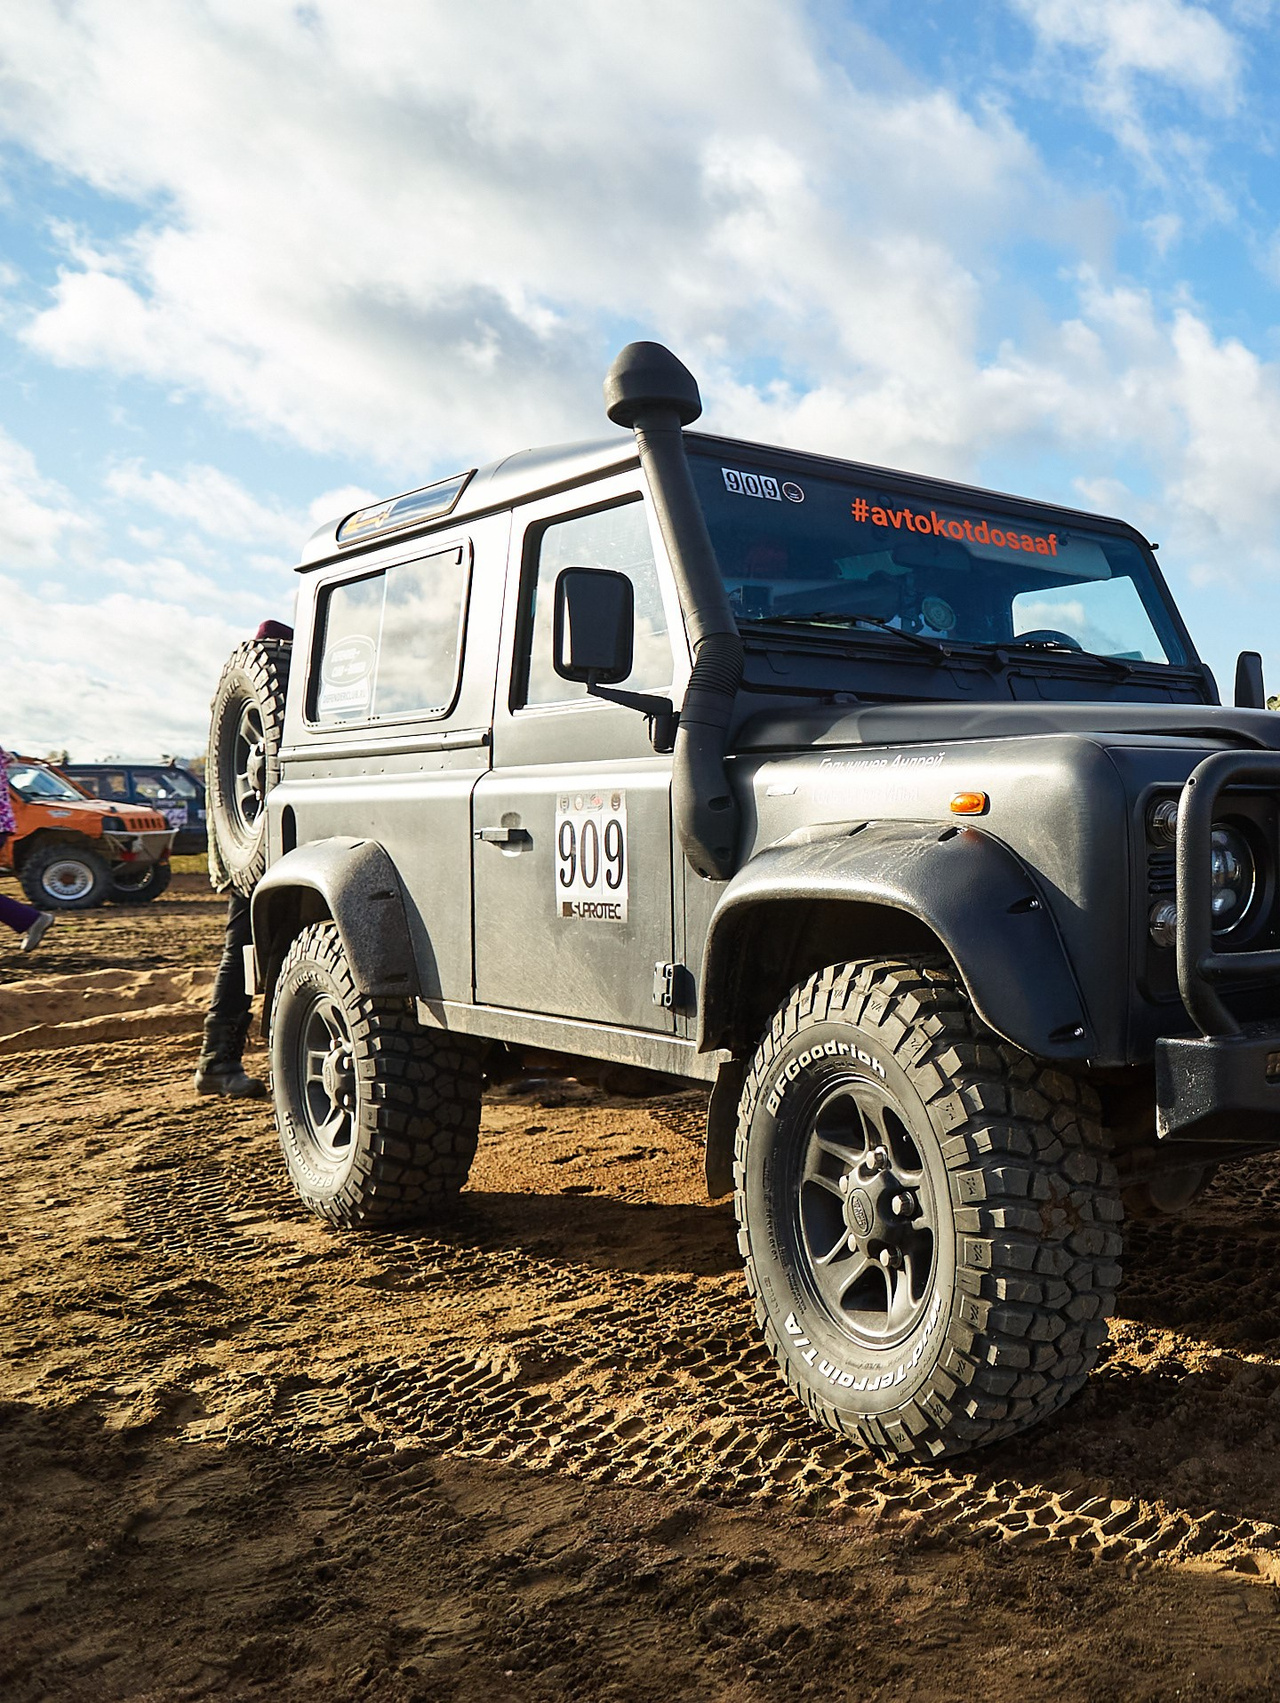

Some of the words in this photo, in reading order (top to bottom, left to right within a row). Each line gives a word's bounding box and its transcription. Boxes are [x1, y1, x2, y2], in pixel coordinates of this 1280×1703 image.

[725, 470, 778, 499] 909
[851, 497, 1059, 557] #avtokotdosaaf
[558, 819, 625, 890] 909
[570, 901, 622, 920] SUPROTEC
[765, 1039, 887, 1118] BFGoodrich
[783, 1310, 819, 1367] T/A
[817, 1289, 943, 1392] Mud-Terrain
